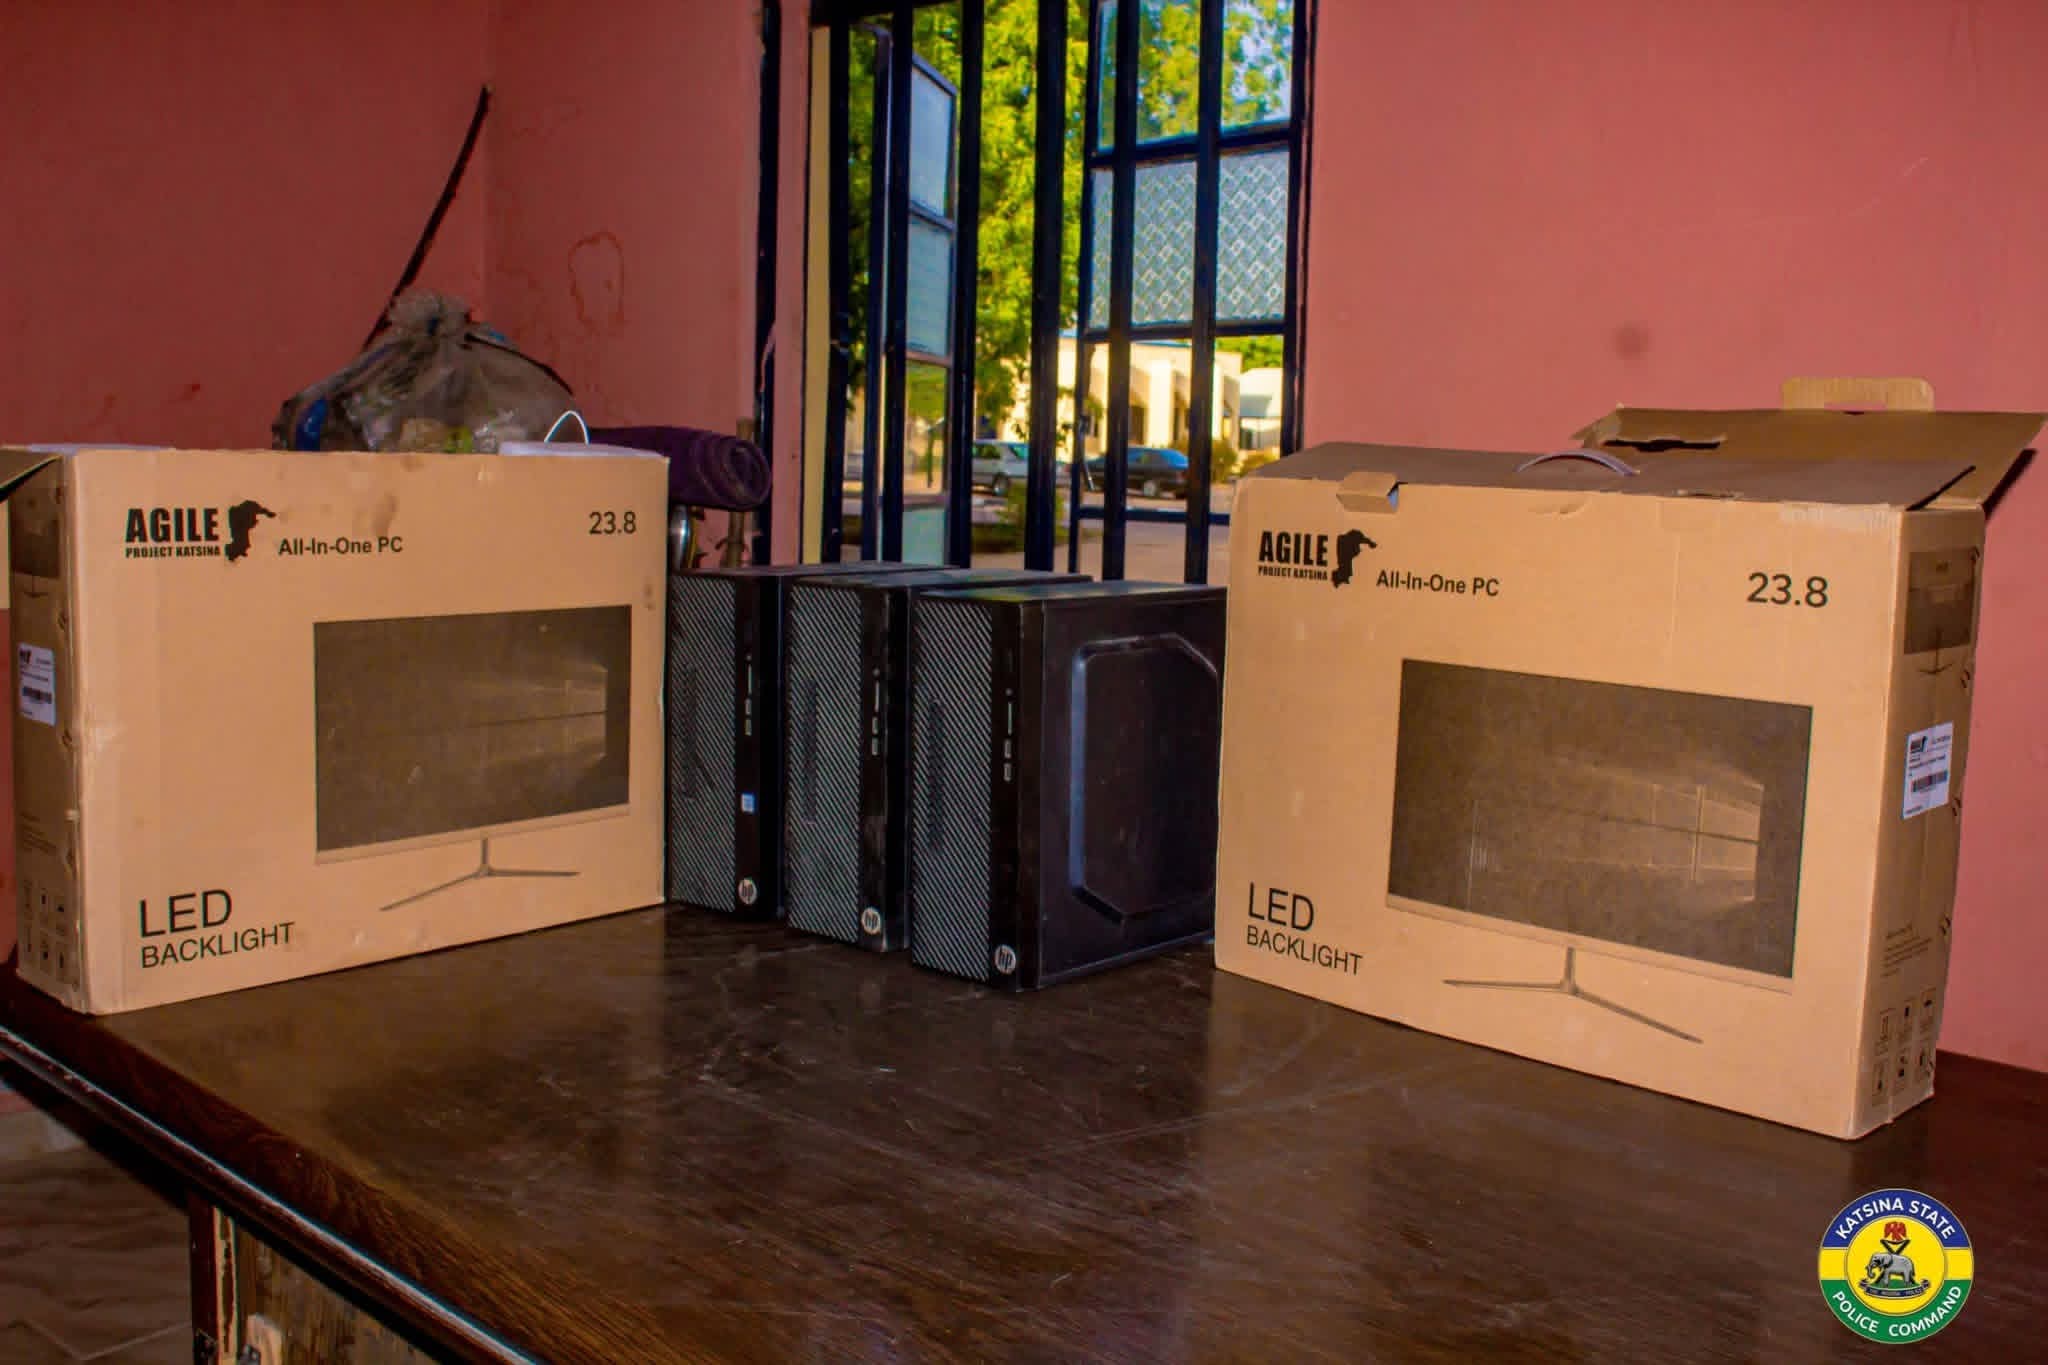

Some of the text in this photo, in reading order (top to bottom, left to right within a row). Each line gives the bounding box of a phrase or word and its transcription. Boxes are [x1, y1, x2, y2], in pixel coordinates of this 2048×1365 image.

[125, 508, 219, 543] AGILE
[589, 511, 637, 535] 23.8
[125, 545, 221, 558] PROJECT KATSINA
[278, 536, 404, 556] All-In-One PC
[1258, 530, 1329, 567] AGILE
[1257, 564, 1329, 581] PROJECT KATSINA
[1376, 569, 1500, 597] All-In-One PC
[1746, 572, 1829, 608] 23.8
[139, 889, 233, 938] LED
[1248, 881, 1314, 931] LED
[141, 921, 296, 969] BACKLIGHT
[1246, 924, 1364, 975] BACKLIGHT
